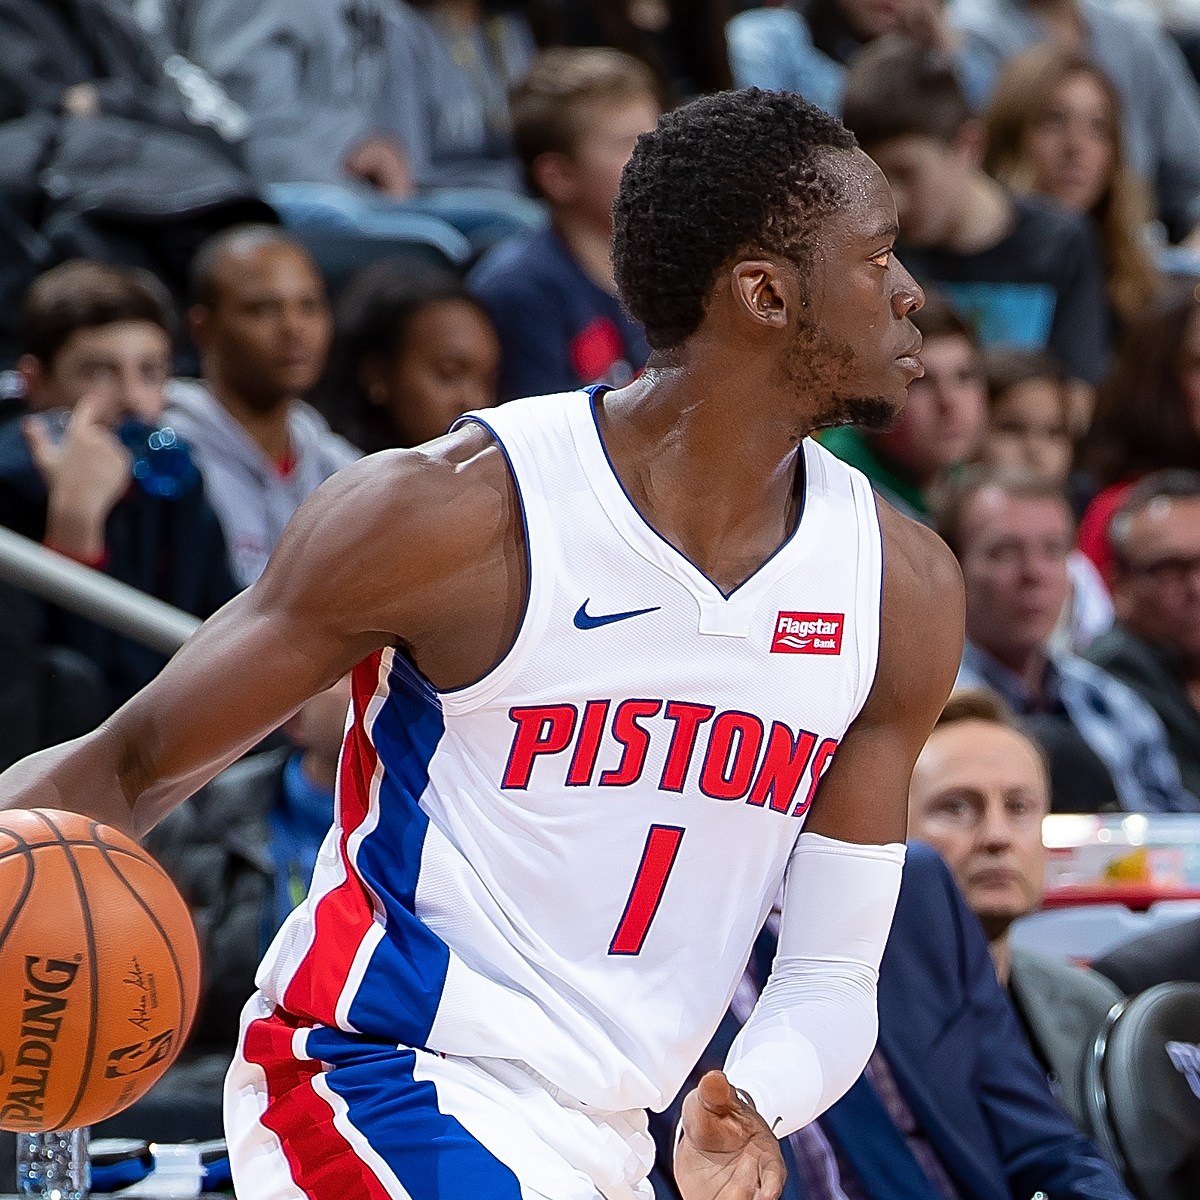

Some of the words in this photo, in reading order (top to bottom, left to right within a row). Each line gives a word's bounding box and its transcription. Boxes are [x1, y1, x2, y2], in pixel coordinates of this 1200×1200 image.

[778, 617, 839, 637] Flagstar
[813, 638, 836, 648] Bank
[500, 698, 839, 817] PISTONS
[607, 824, 686, 956] 1
[0, 955, 80, 1127] PALDING
